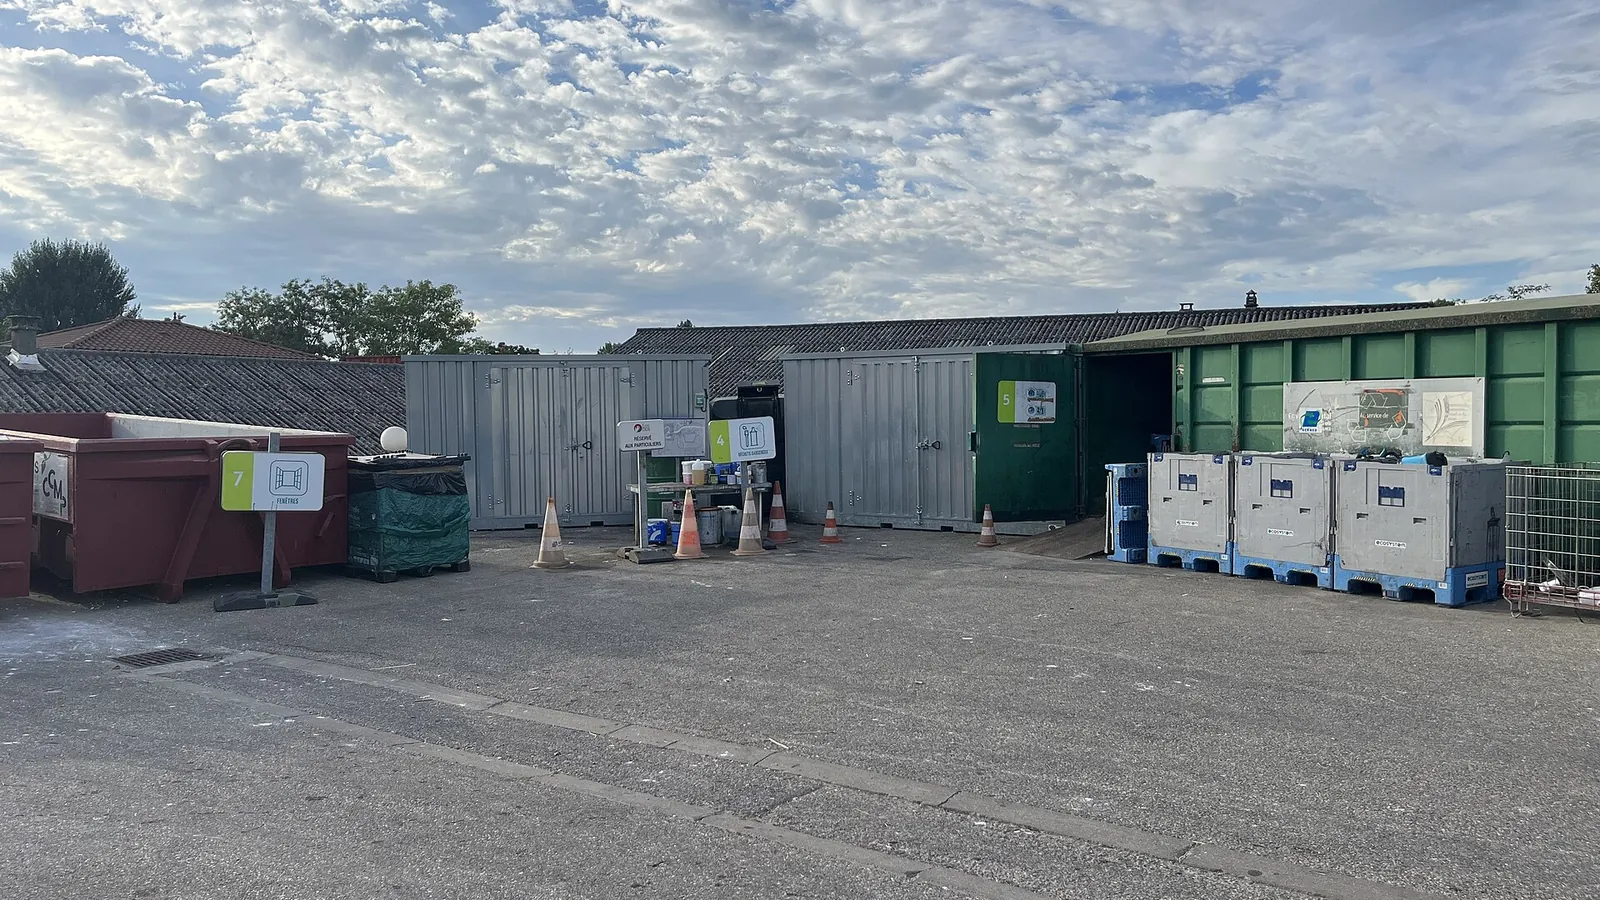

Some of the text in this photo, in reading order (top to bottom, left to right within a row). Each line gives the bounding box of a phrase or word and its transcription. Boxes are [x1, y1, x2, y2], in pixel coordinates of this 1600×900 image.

[1003, 394, 1010, 405] 5
[716, 434, 725, 446] 4
[233, 471, 243, 487] 7
